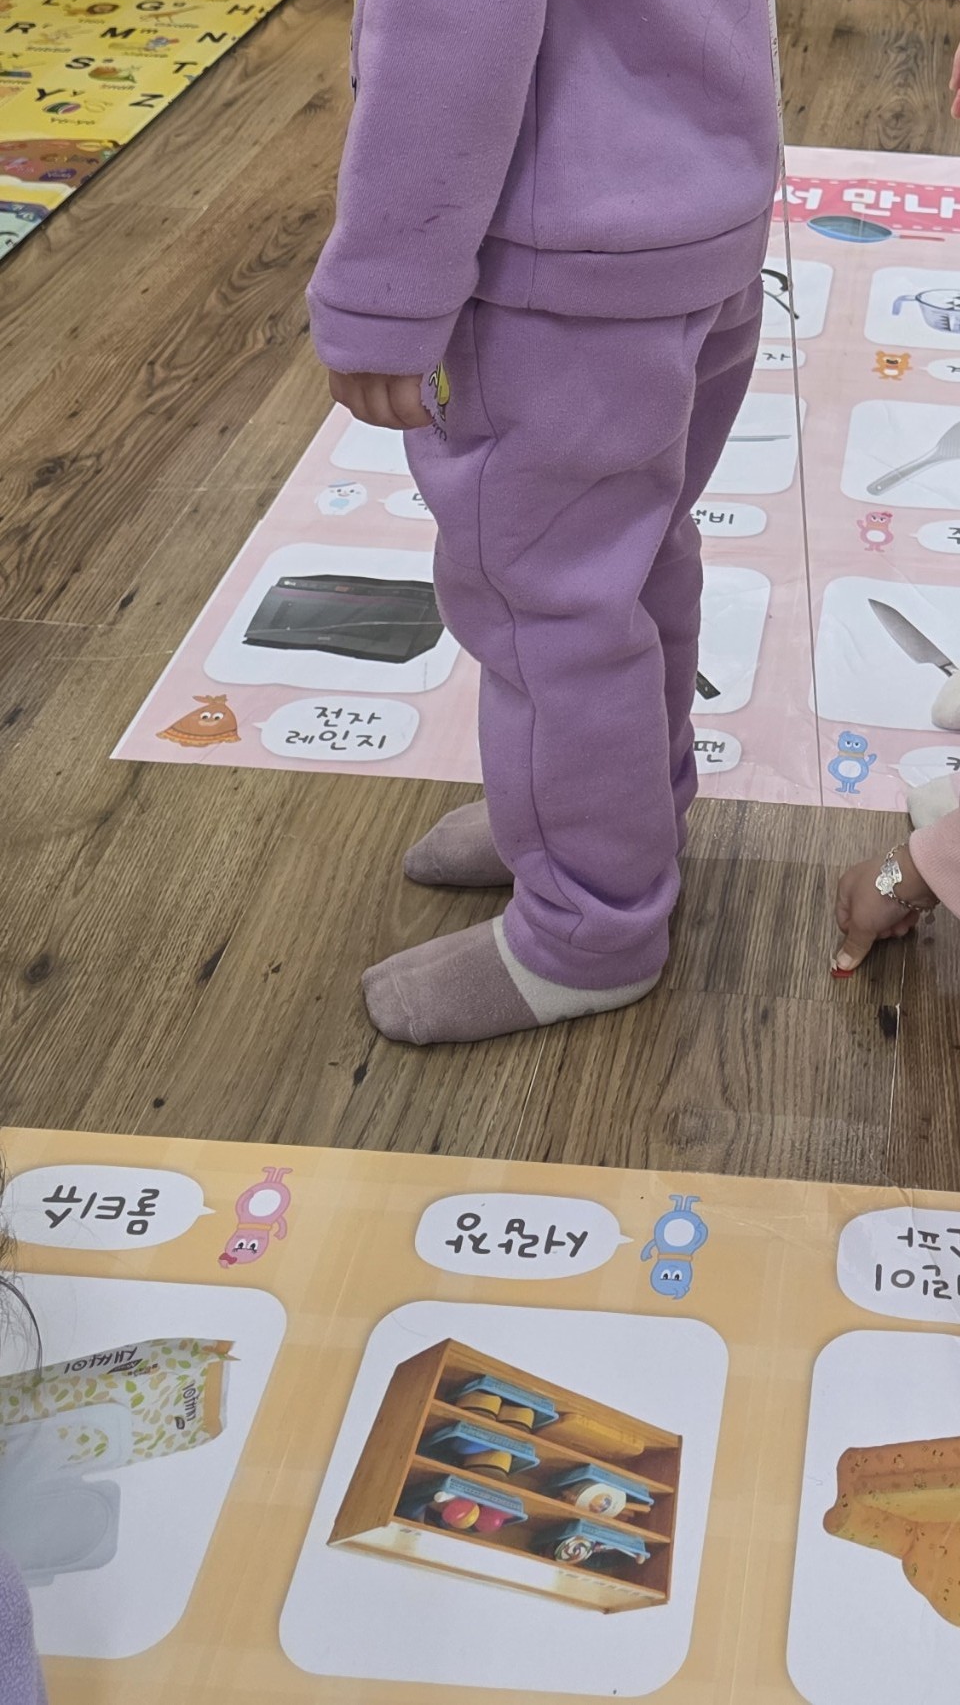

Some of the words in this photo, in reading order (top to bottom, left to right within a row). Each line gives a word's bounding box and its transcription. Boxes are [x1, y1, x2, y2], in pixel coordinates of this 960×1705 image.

[101, 27, 137, 39] M
[197, 32, 228, 43] N
[774, 184, 823, 210] 서
[314, 705, 382, 726] 전자
[285, 730, 386, 751] 레인지
[694, 740, 726, 763] 팬
[42, 1184, 160, 1236] 물티슈
[446, 1212, 588, 1260] 서랍장
